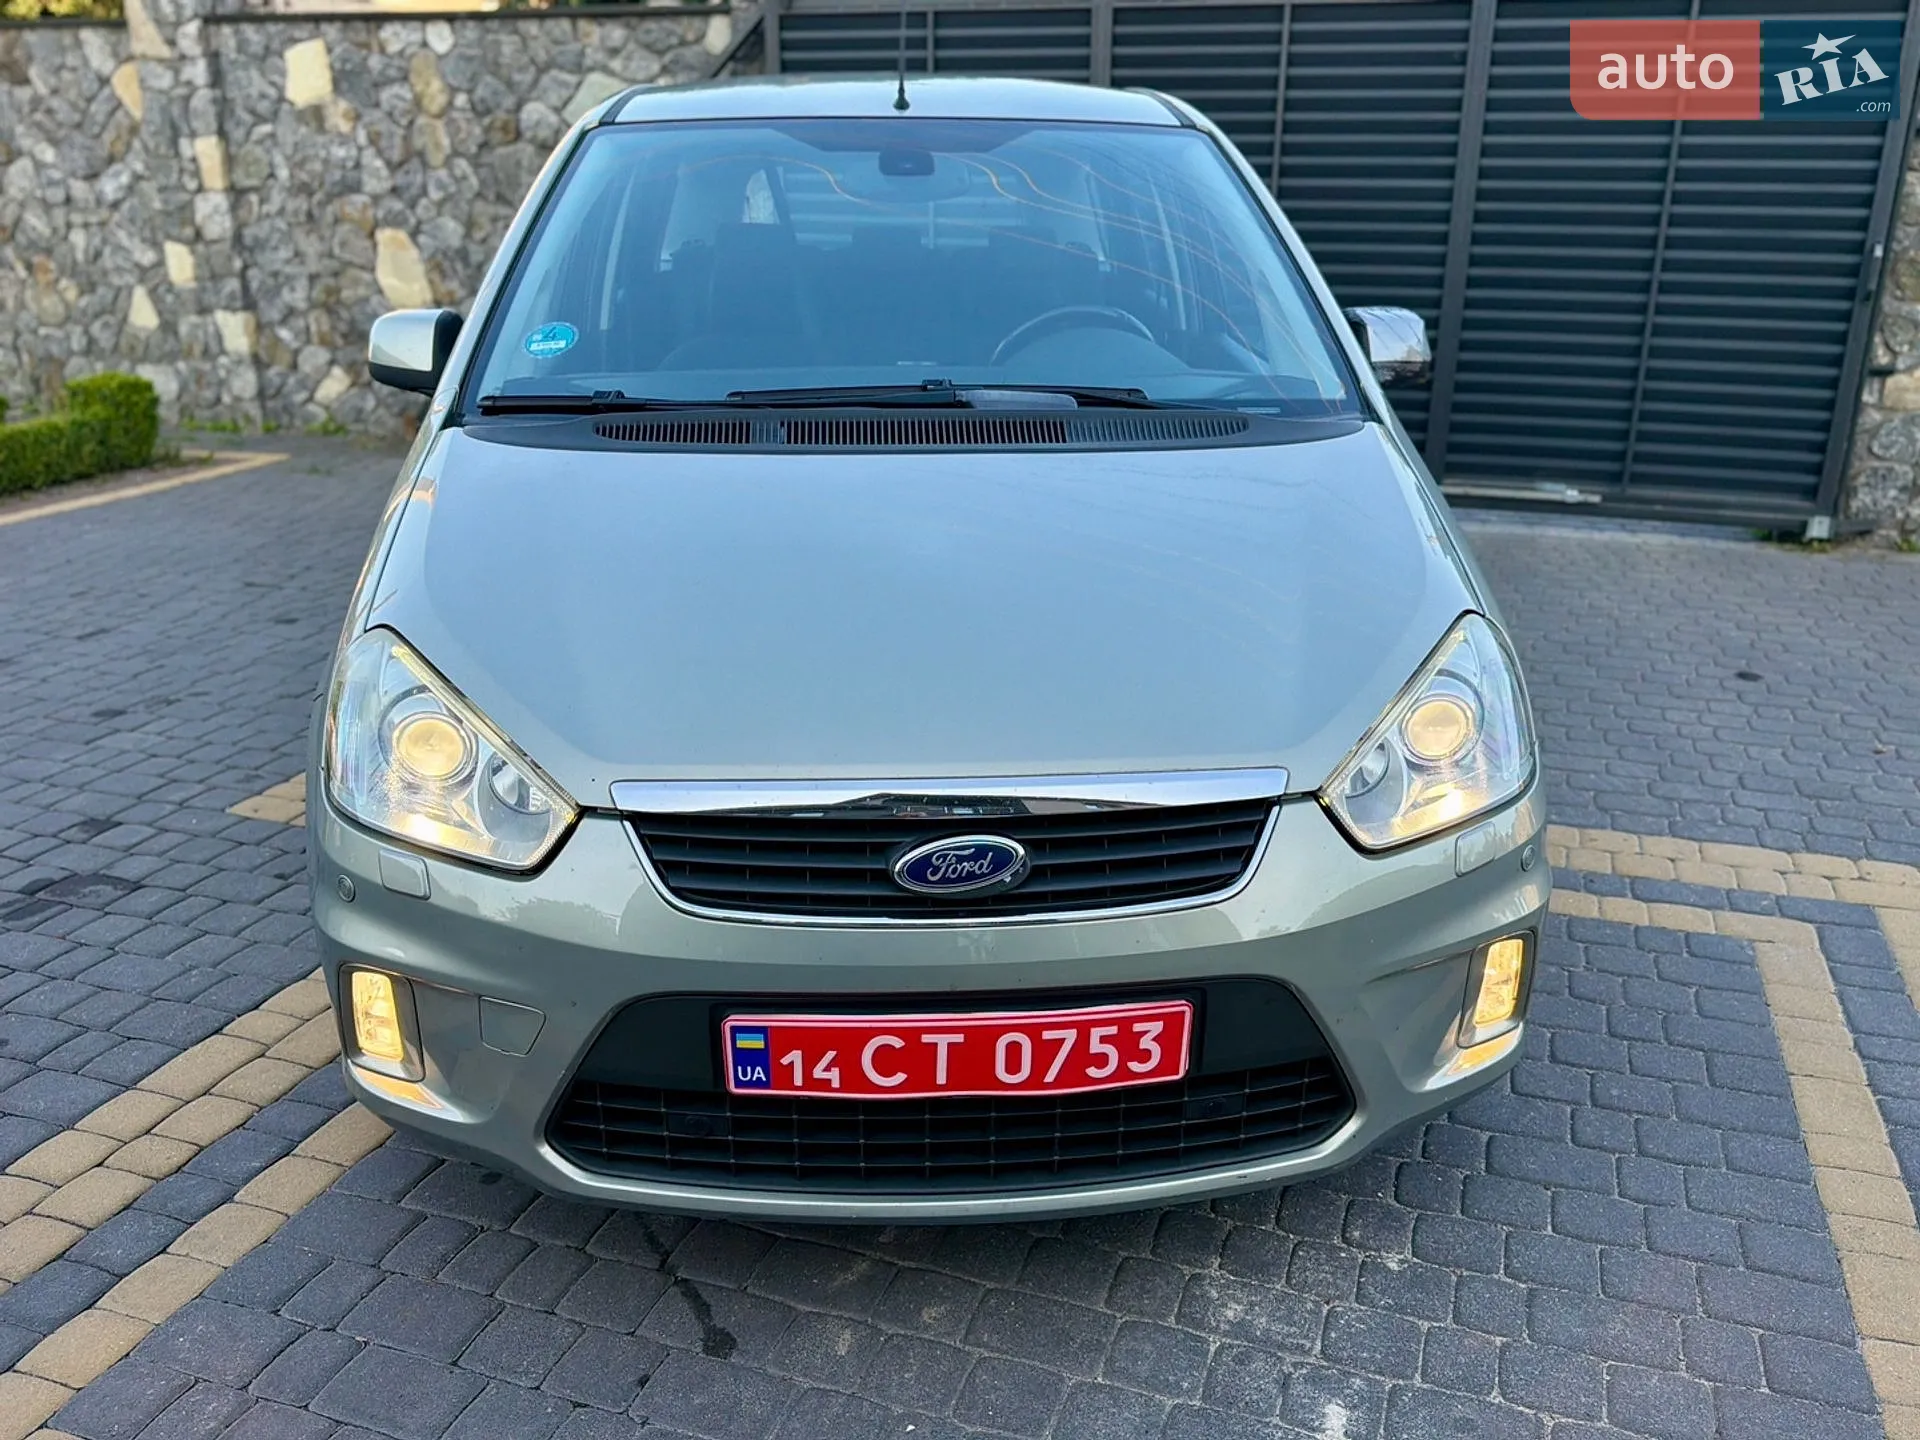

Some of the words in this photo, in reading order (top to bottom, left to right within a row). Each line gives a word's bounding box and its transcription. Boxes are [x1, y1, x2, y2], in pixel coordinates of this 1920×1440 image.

[926, 848, 994, 882] Ford
[779, 1049, 841, 1088] 14
[861, 1033, 965, 1088] CT
[994, 1020, 1164, 1085] 0753
[737, 1065, 767, 1083] UA
